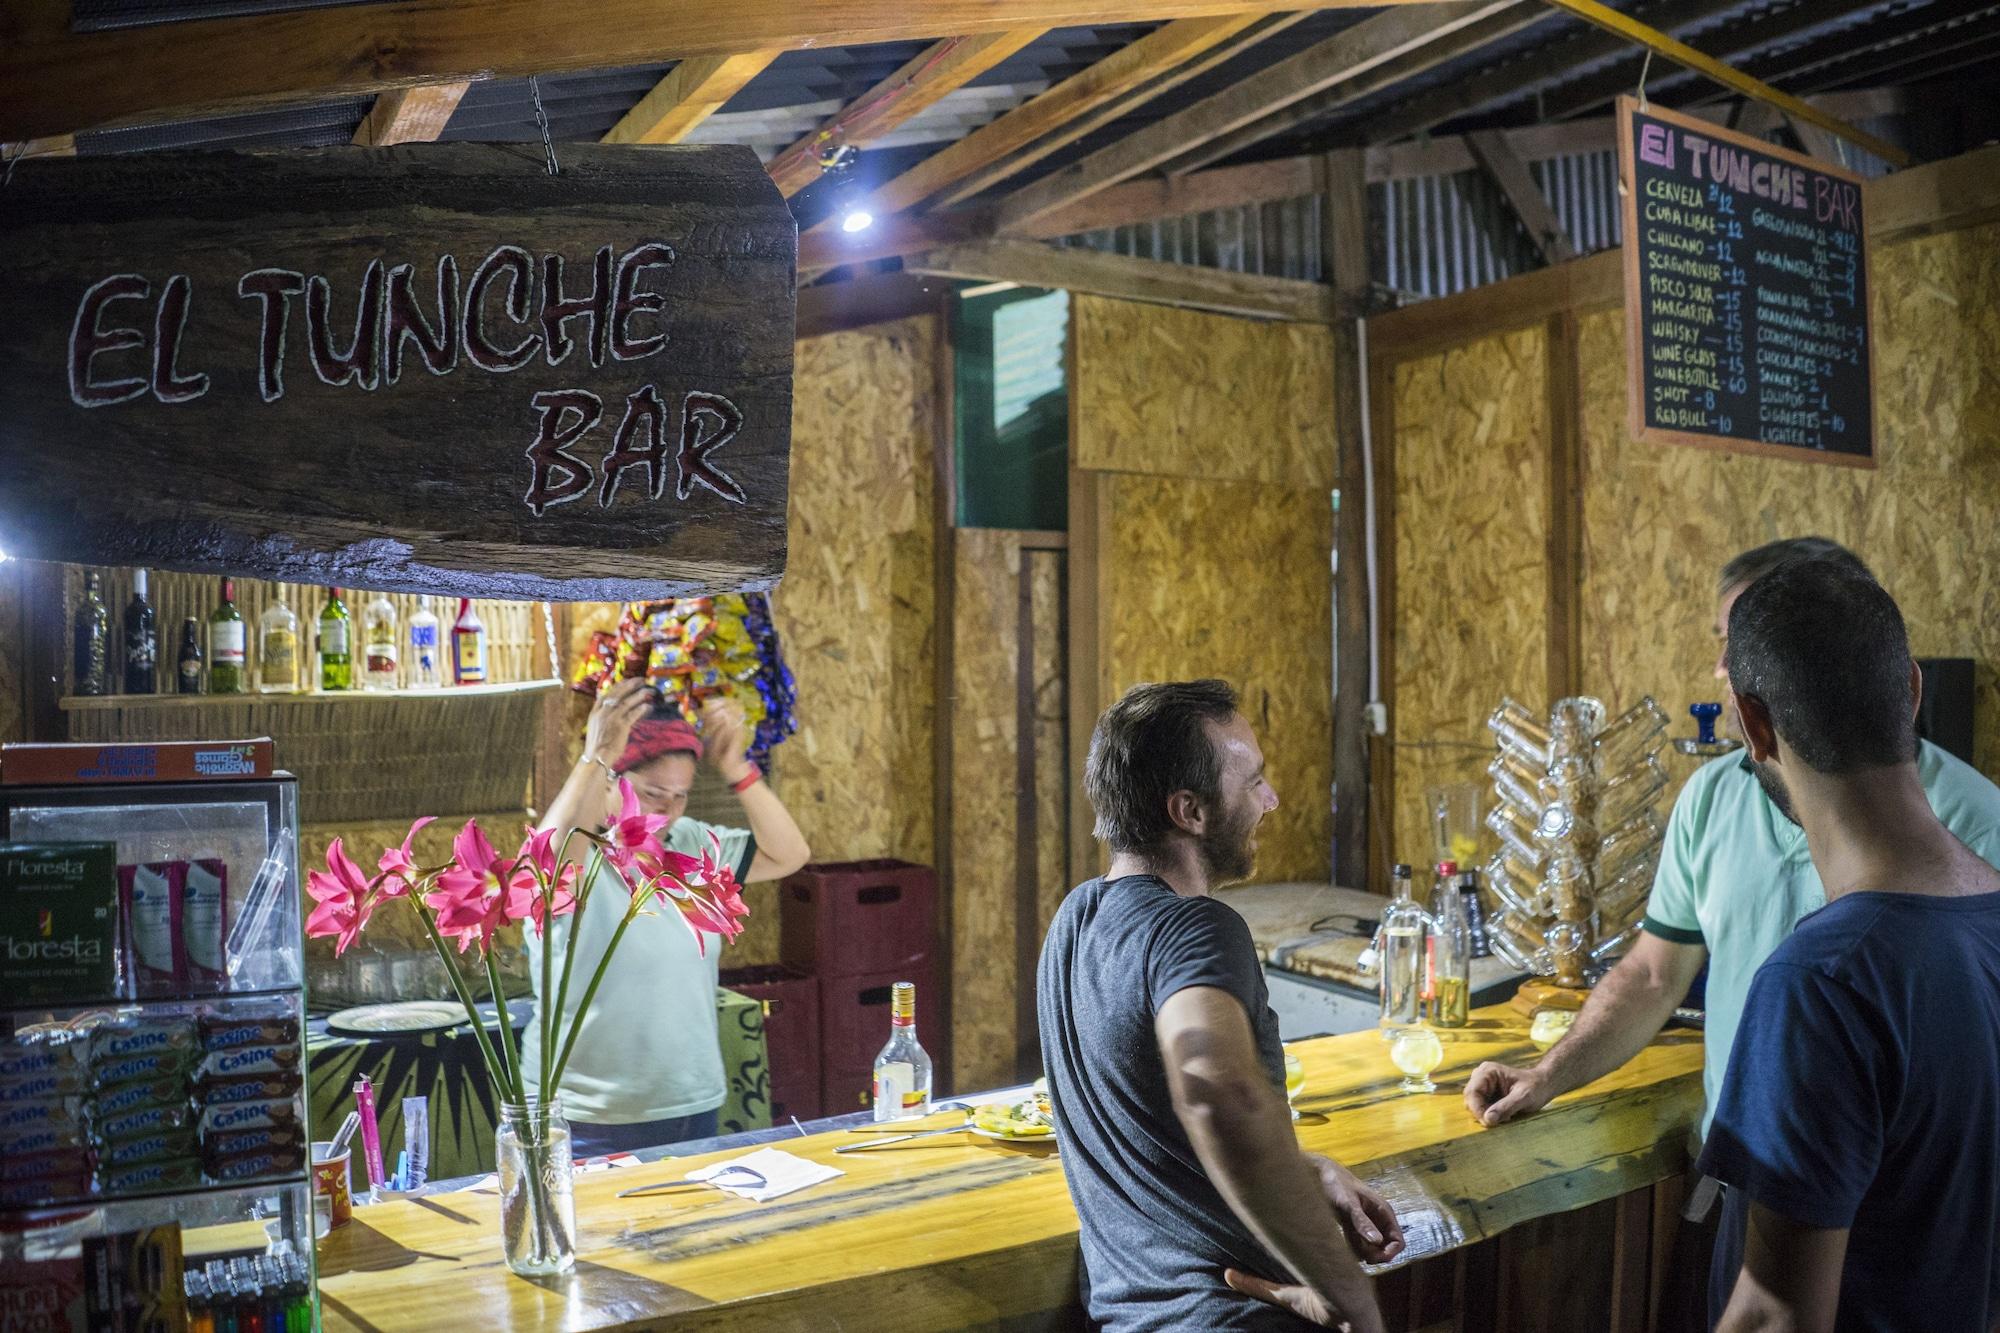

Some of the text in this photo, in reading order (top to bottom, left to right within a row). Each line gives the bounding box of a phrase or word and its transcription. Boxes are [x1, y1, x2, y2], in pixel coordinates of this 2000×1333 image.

[1646, 178, 1703, 209] CERVEZA
[1683, 134, 1808, 209] TUNCHE
[1814, 176, 1859, 235] BAR
[1646, 201, 1681, 225] CUBA
[1684, 212, 1717, 235] LIBRE
[1648, 228, 1704, 256] CHILCANO
[1649, 251, 1722, 281] SCREWDRIVER
[1650, 273, 1685, 298] PISCO
[1688, 283, 1714, 304] SOUR
[68, 243, 675, 409] EL TUNCHE
[1652, 299, 1715, 325] MARGARITA
[1652, 321, 1699, 344] WHISKY
[1652, 344, 1682, 362] WINE
[1684, 347, 1716, 368] GLASS
[1654, 386, 1690, 403] SHOT
[1656, 405, 1677, 424] RED
[1680, 408, 1708, 427] BULL
[525, 385, 746, 515] BAR
[195, 752, 242, 763] Games
[195, 762, 255, 775] Magnetic
